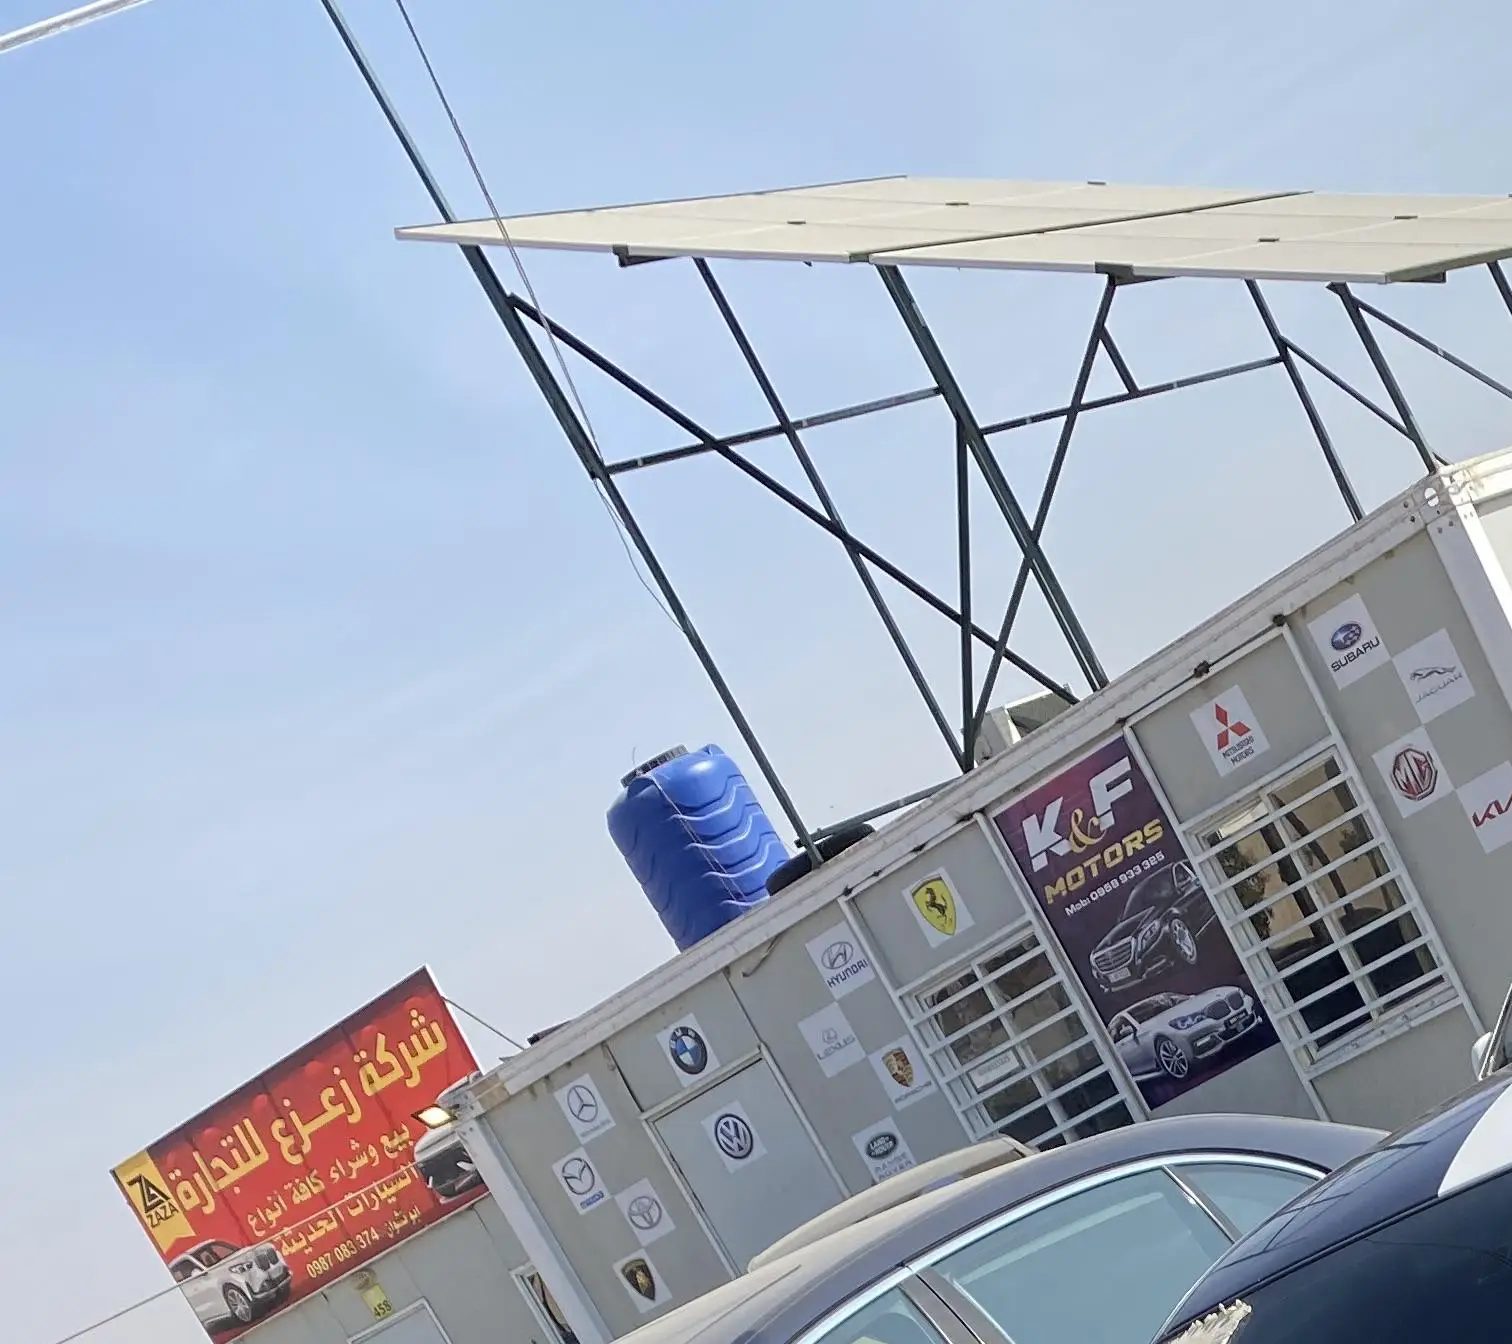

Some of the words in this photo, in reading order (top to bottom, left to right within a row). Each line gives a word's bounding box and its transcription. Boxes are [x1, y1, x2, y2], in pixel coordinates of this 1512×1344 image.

[1330, 635, 1381, 673] SUBARU
[1022, 756, 1134, 873] K&F
[1044, 818, 1164, 905] MOTORS
[826, 959, 869, 988] HYUNDAI
[353, 1008, 448, 1097] شركة
[816, 1035, 856, 1061] LEXUS
[330, 1138, 381, 1185] وشراء
[380, 1123, 415, 1159] بيع
[168, 1117, 270, 1216] للتجارة
[284, 1168, 326, 1205] كافة
[344, 1161, 420, 1218] السيارات
[146, 1201, 179, 1229] ZAZA
[306, 1252, 333, 1279] 0987
[333, 1239, 358, 1264] 083
[355, 1226, 381, 1250] 374
[373, 1298, 393, 1319] 458
